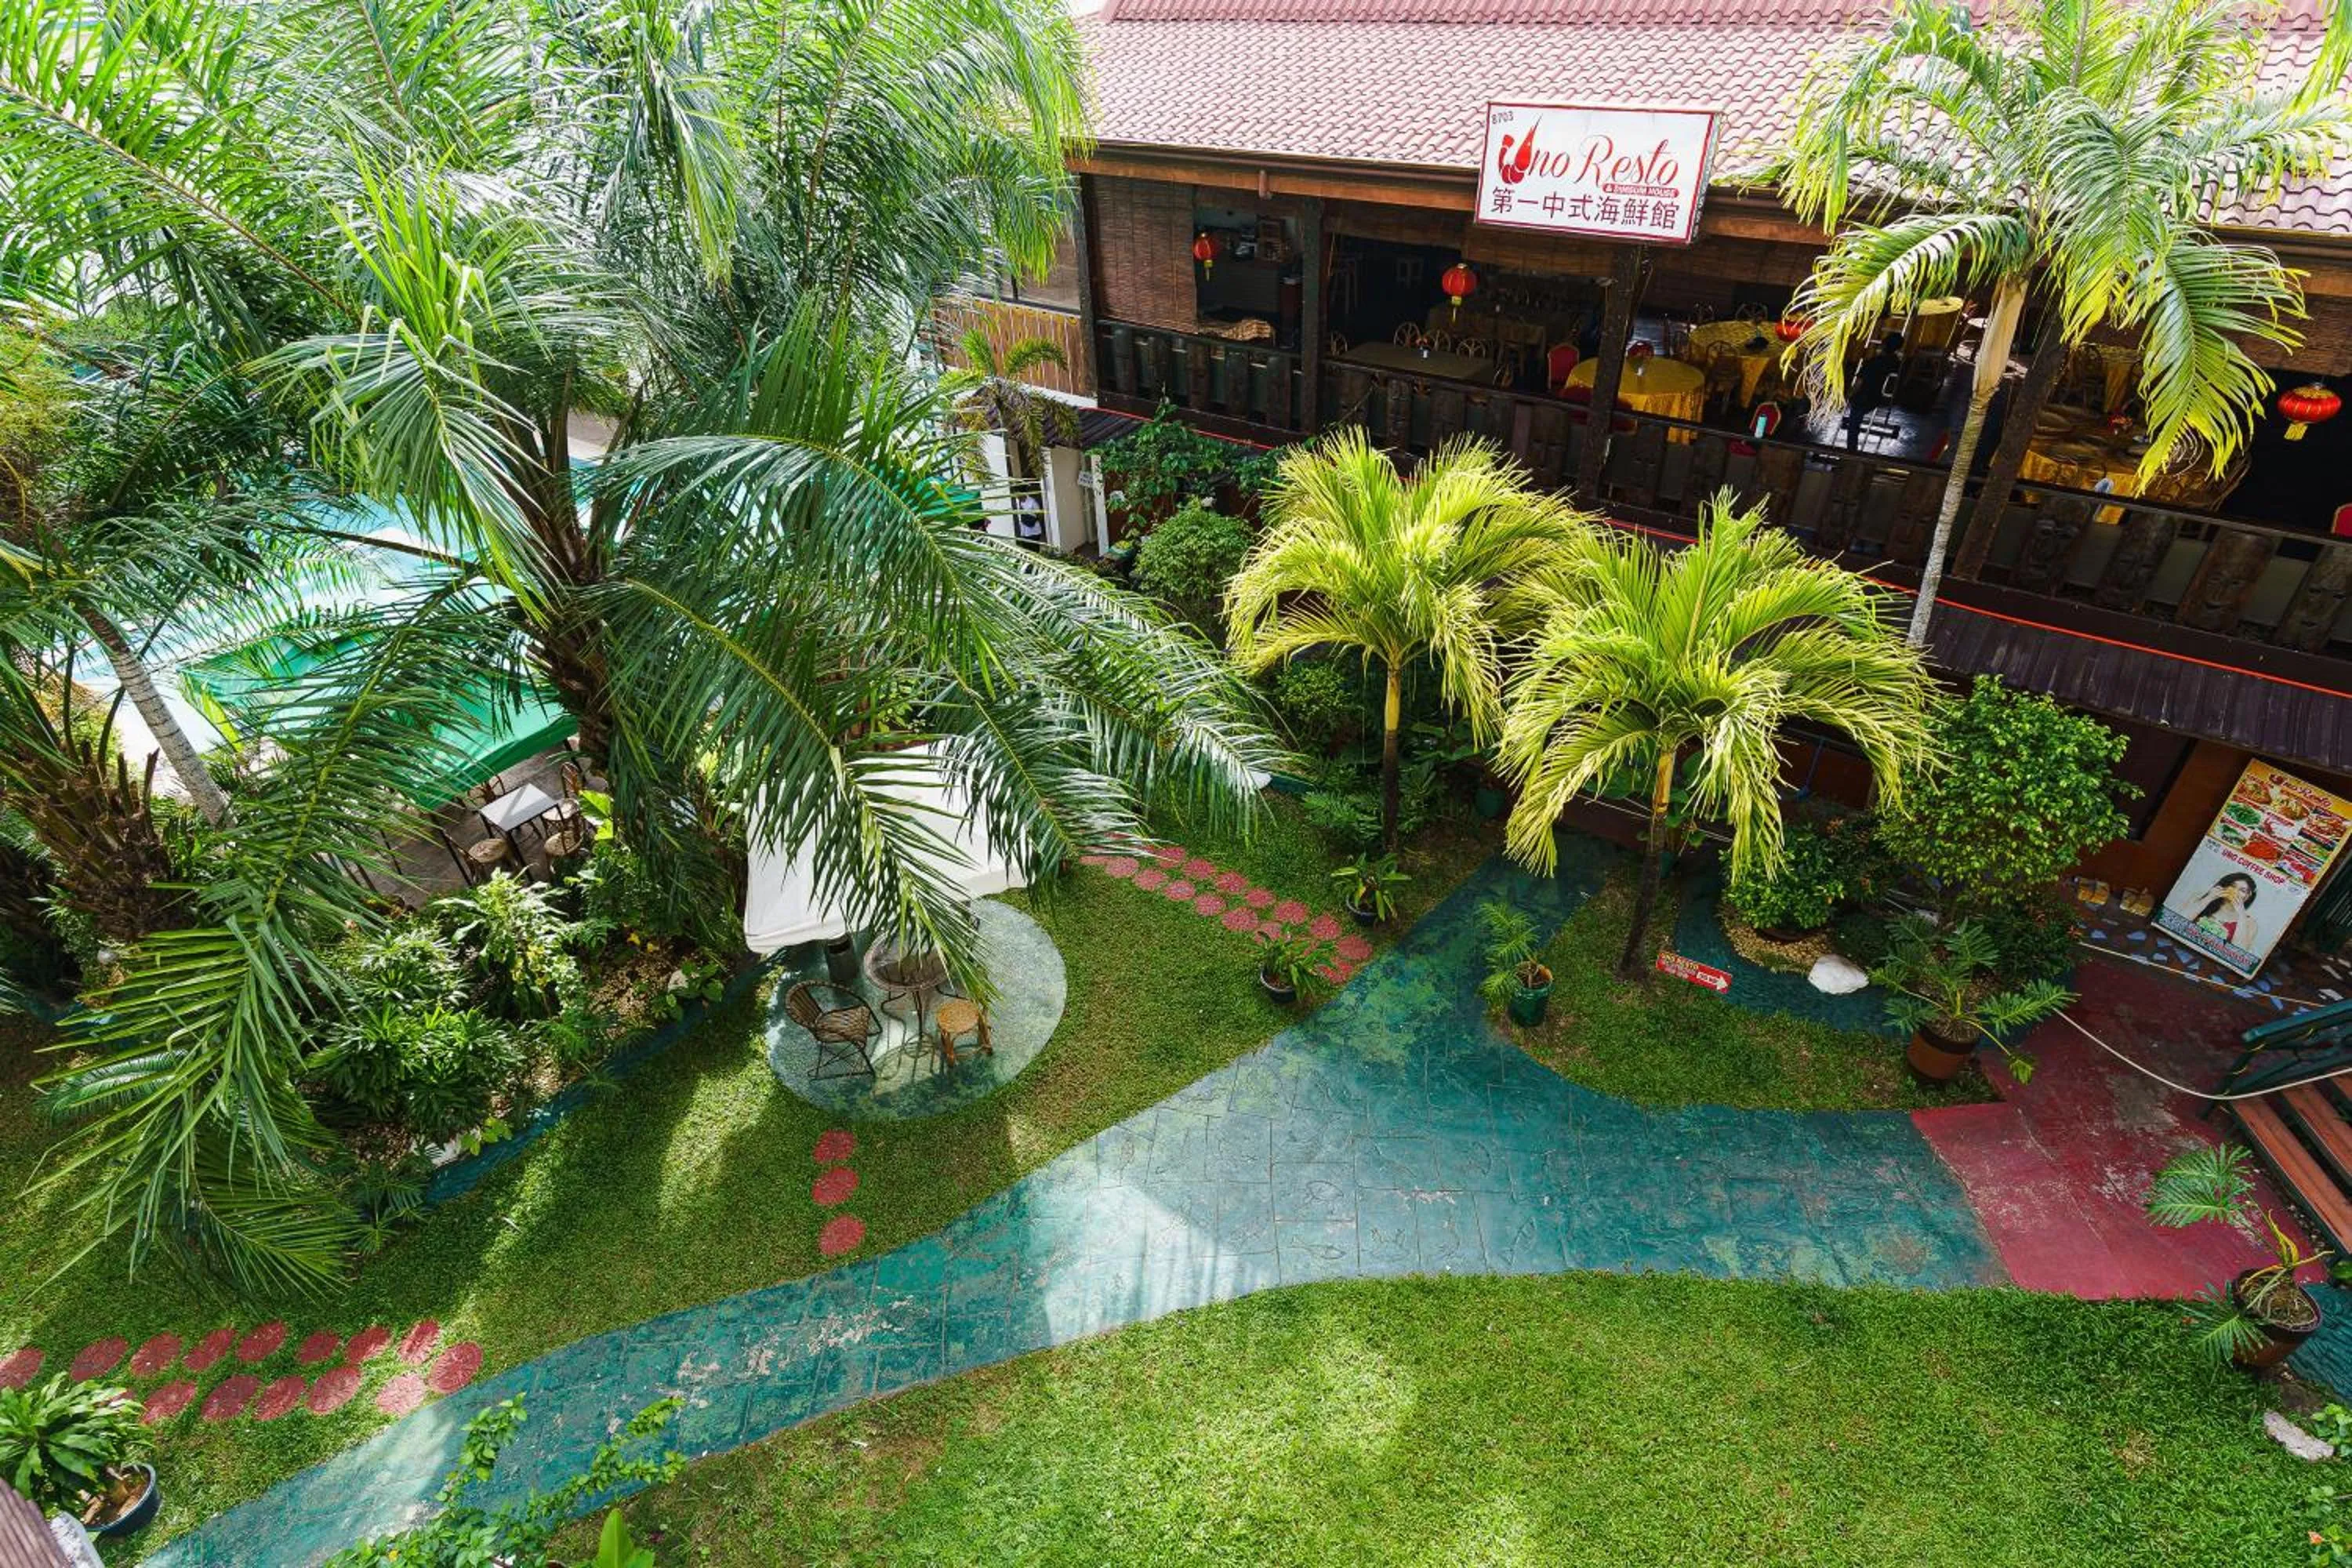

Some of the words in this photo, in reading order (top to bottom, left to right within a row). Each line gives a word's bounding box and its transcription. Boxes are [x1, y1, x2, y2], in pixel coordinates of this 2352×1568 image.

[1491, 111, 1514, 124] 8703
[1498, 116, 1570, 184] Uno
[1573, 134, 1679, 187] Resto
[1490, 186, 1680, 230] 第一中式海鮮館
[2221, 849, 2238, 861] UNO
[2237, 857, 2265, 875] COFFEE
[2263, 871, 2285, 885] SHOP
